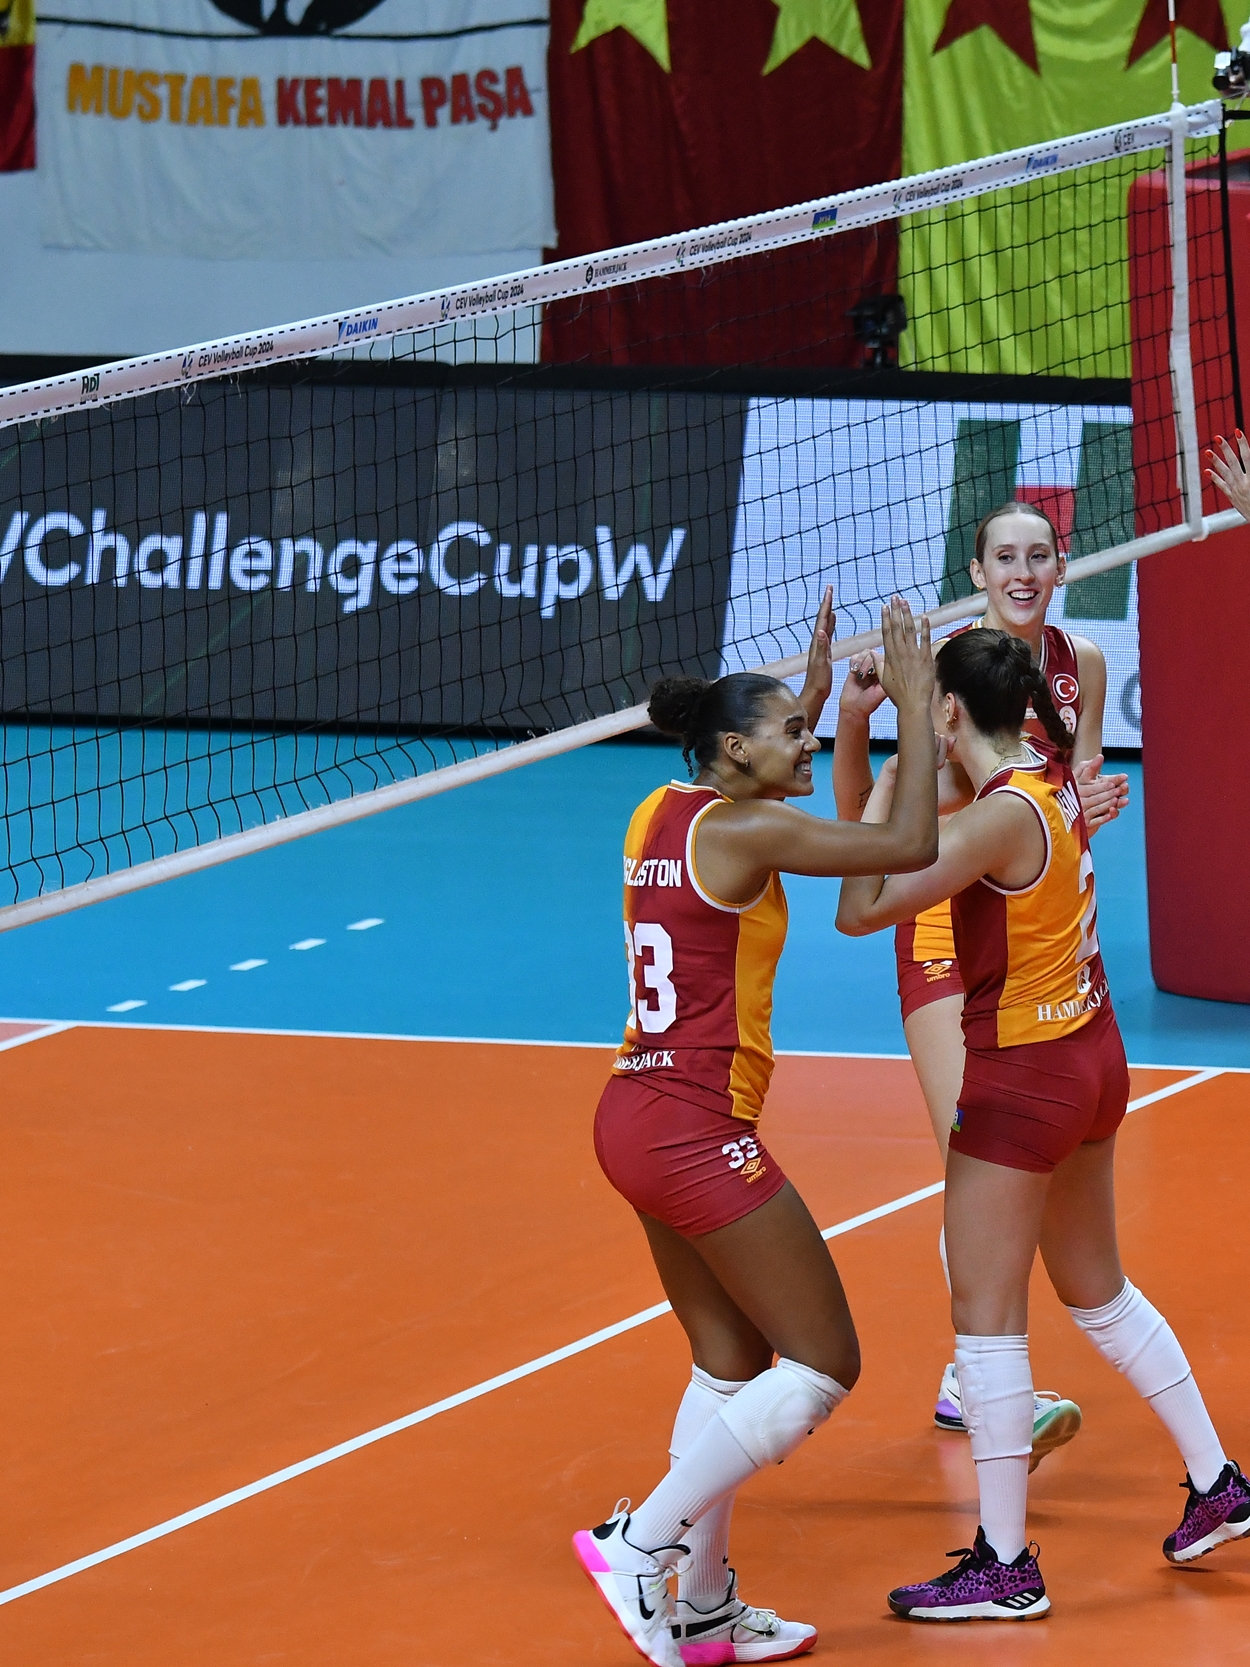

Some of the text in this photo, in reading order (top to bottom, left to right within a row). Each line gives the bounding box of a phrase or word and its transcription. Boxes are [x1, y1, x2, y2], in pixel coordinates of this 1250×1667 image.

[67, 62, 535, 131] MUSTAFA KEMAL PAŞA
[689, 244, 700, 256] CEV
[701, 237, 727, 254] Volleyball
[727, 236, 738, 249] Cup
[455, 284, 524, 310] CEV Volleyball Cup 2024
[345, 318, 378, 337] DAIKIN
[198, 340, 274, 368] CEV Volleyball Cup 2024
[926, 972, 951, 983] umbro
[721, 1135, 759, 1169] 33
[746, 1166, 767, 1183] umbro
